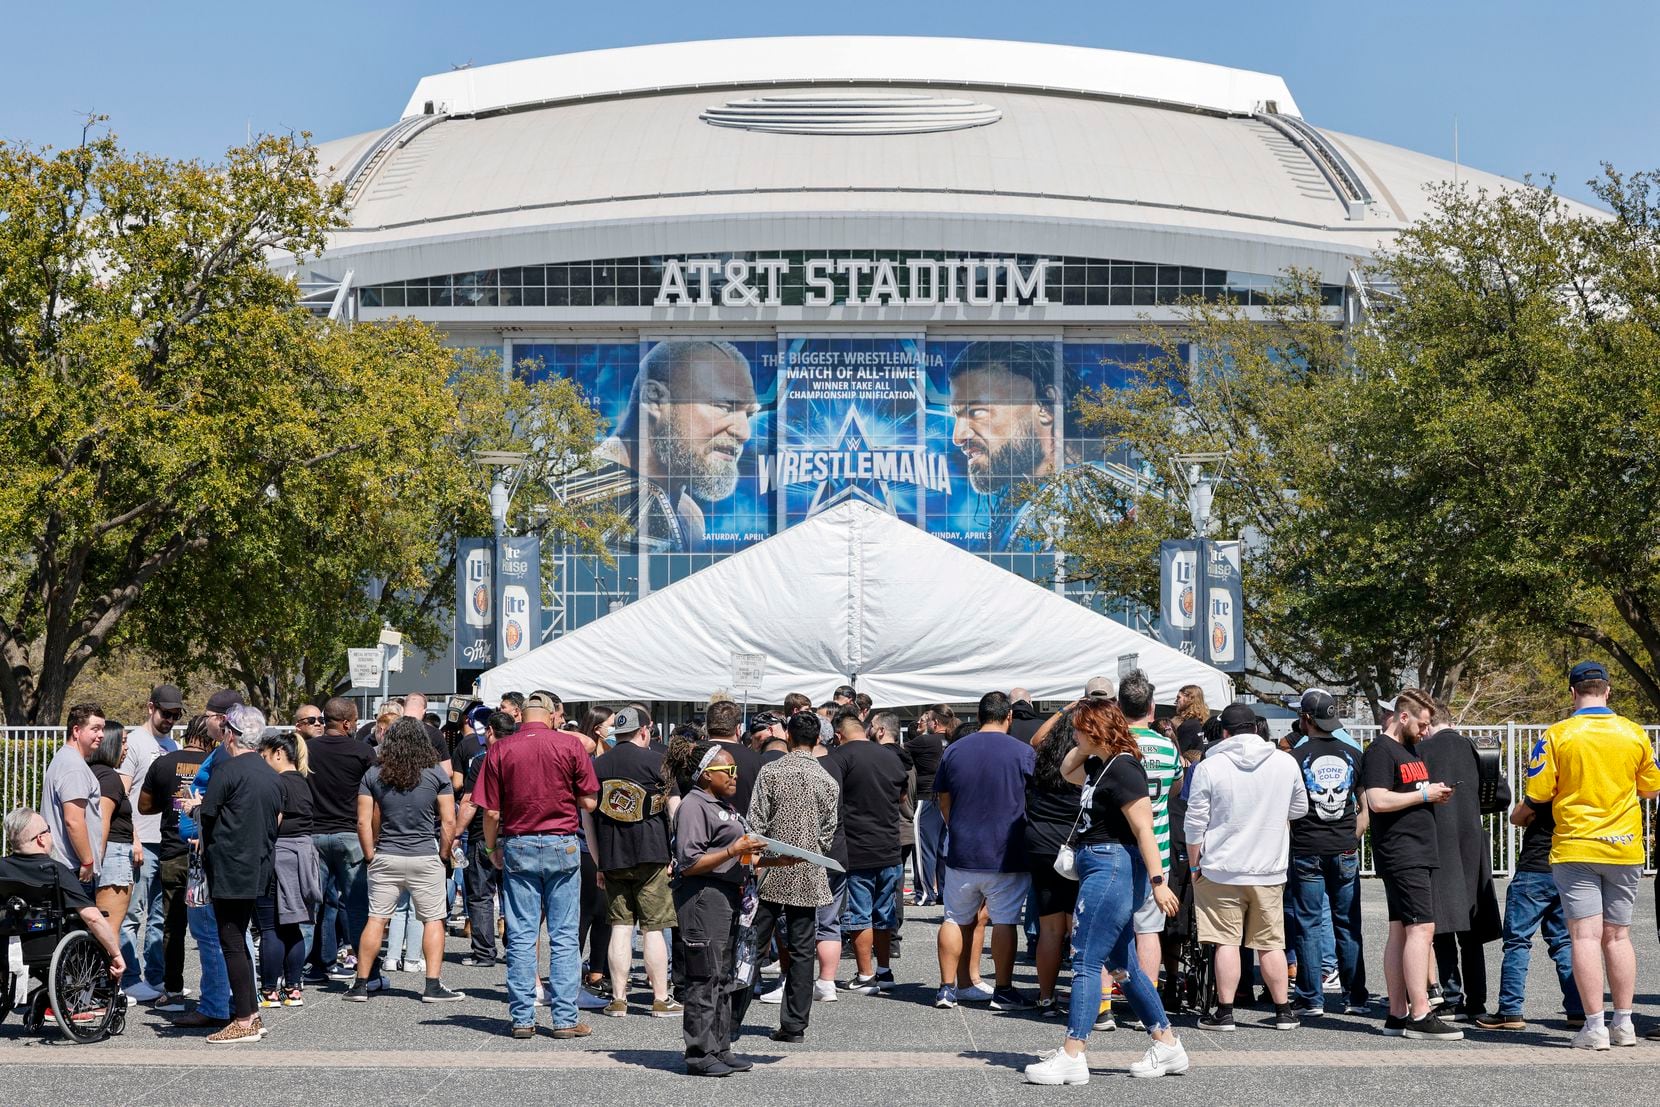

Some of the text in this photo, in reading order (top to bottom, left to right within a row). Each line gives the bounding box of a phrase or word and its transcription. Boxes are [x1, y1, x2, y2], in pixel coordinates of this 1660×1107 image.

[653, 258, 1050, 307] AT&T STADIUM
[761, 351, 944, 367] THE BIGGEST WRESTLEMANIA
[786, 366, 920, 379] MATCH OF ALL-TIME!
[812, 381, 890, 391] WINNER TAKE ALL
[789, 390, 917, 400] CHAMPIONSHIP UNIFICATION
[758, 451, 952, 496] WRESTLEMANIA
[702, 532, 742, 542] SATURDAY,
[744, 532, 765, 541] APRIL
[931, 531, 992, 540] SUNDAY, APRIL 3
[1317, 767, 1344, 775] STONE
[1319, 773, 1341, 781] COLD
